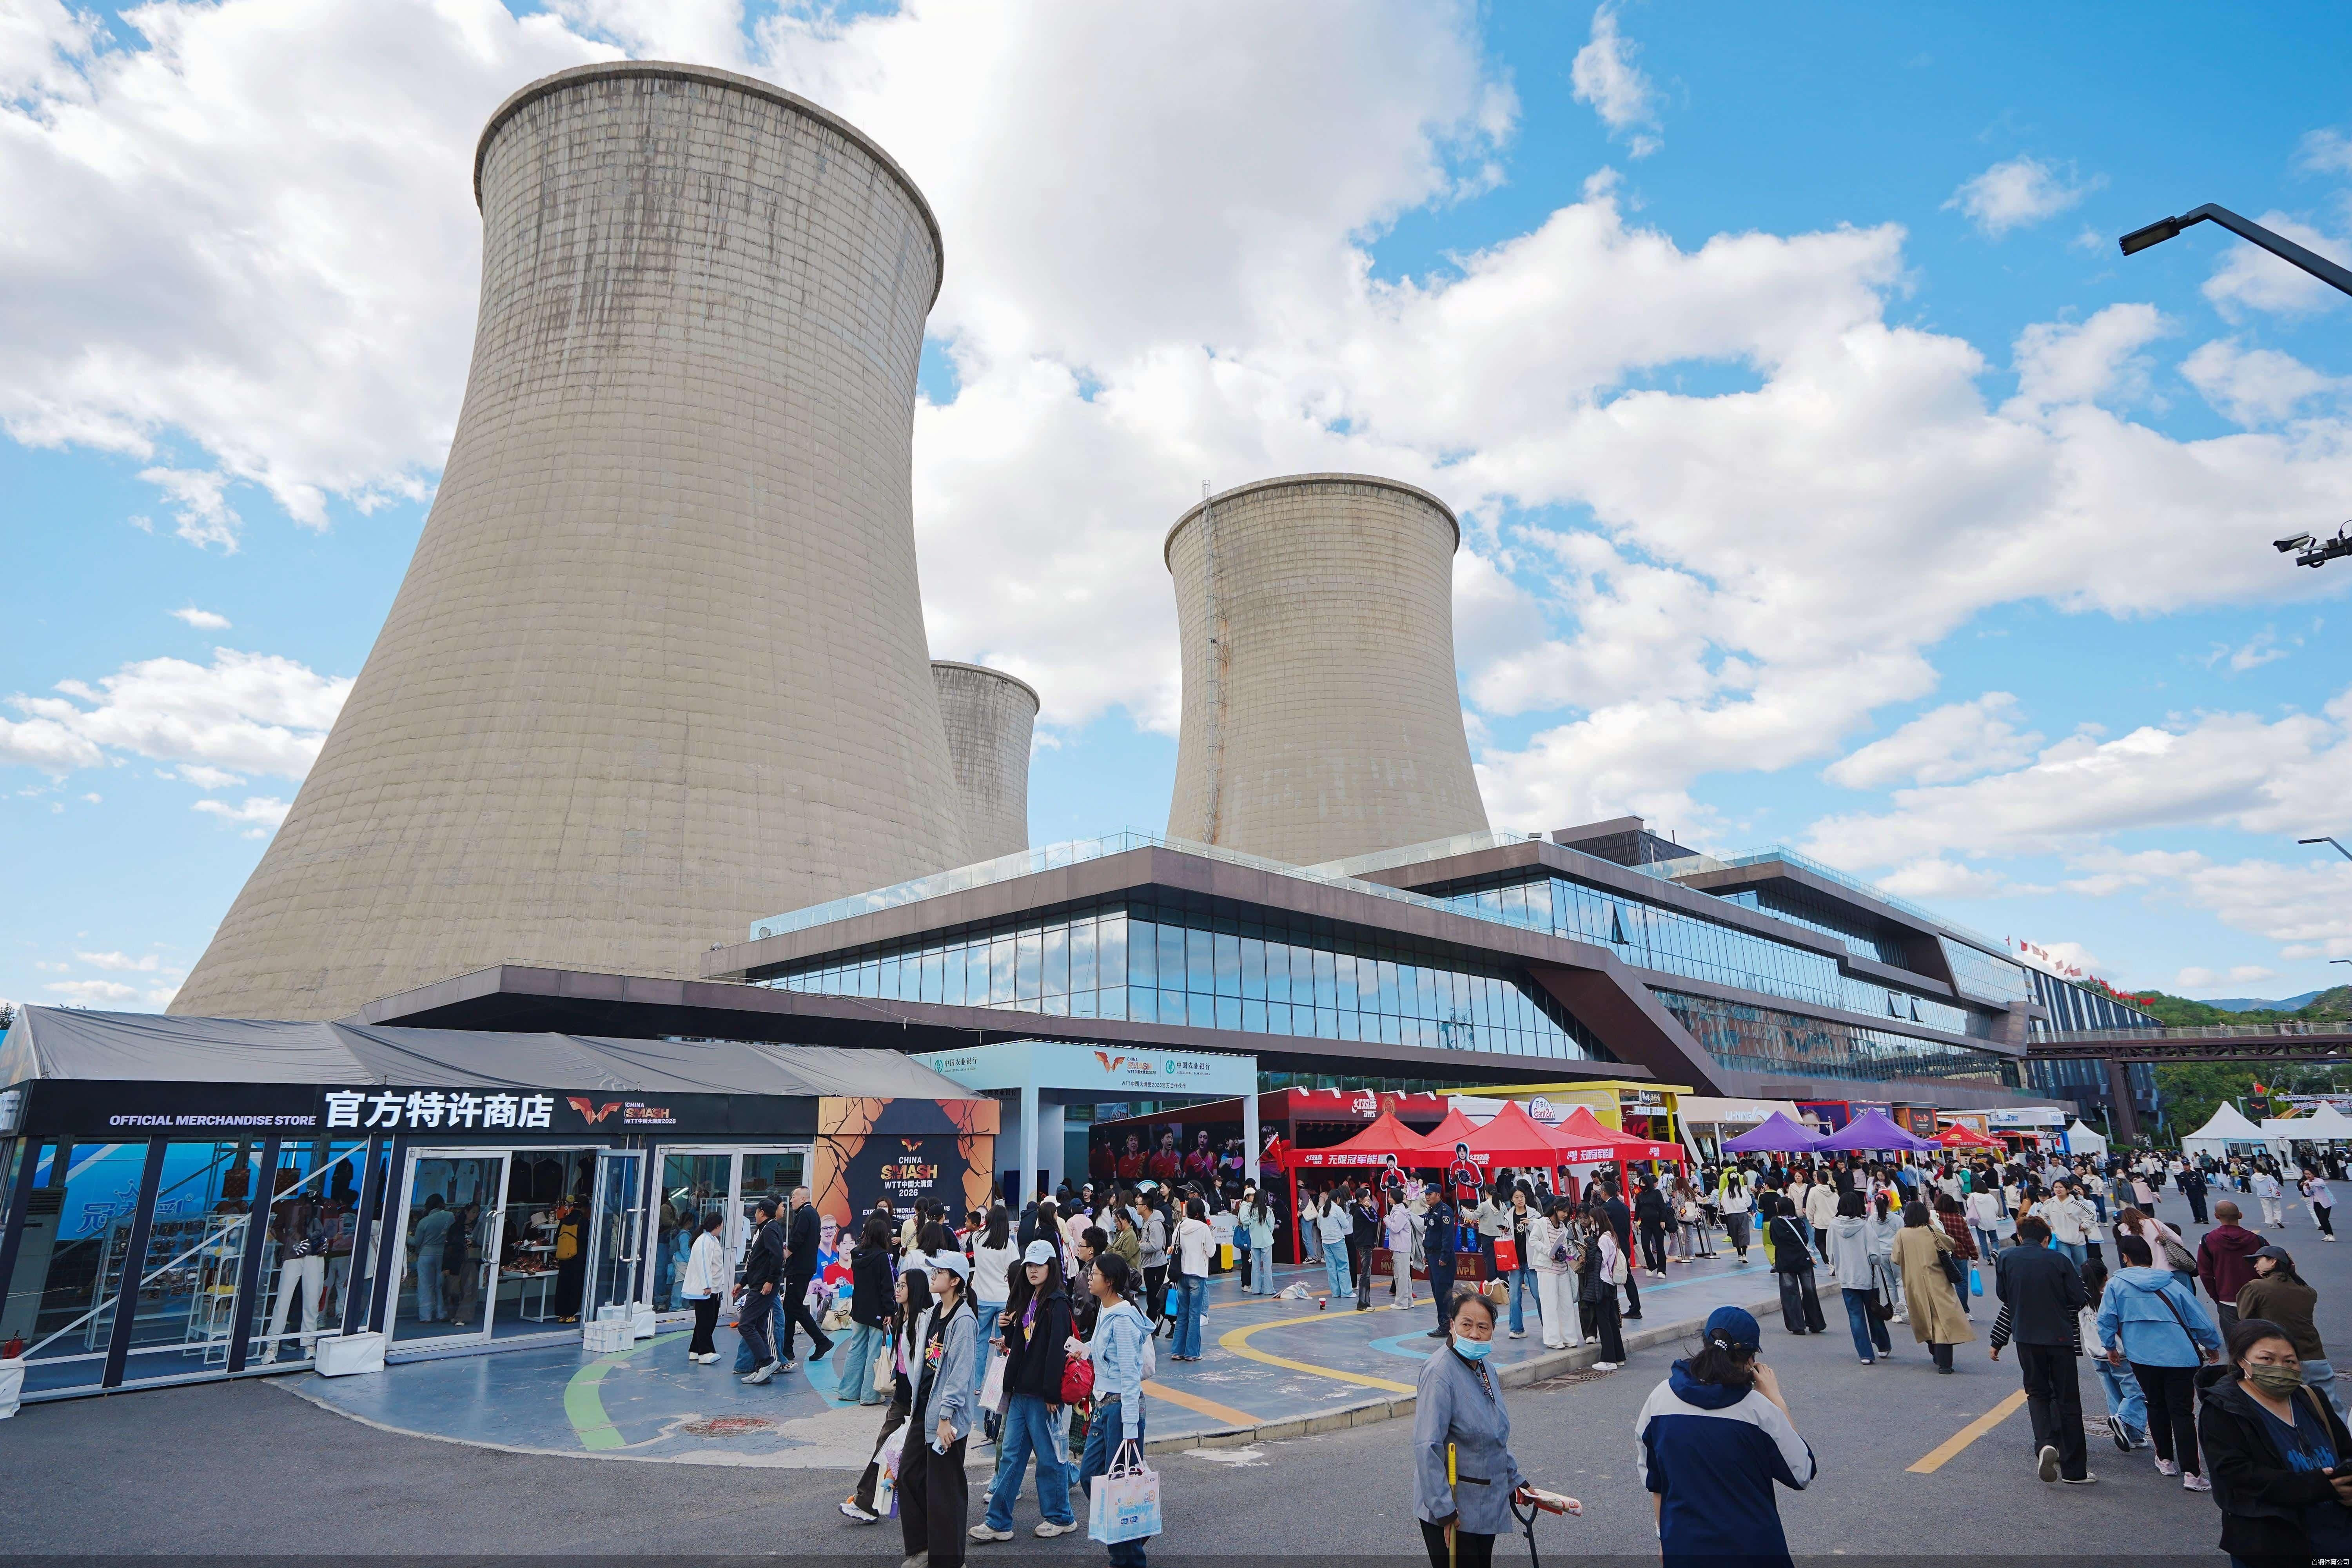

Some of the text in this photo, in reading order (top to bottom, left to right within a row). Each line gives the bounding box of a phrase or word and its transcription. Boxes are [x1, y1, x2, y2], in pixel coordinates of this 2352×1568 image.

[945, 1057, 977, 1067] 中国农业银行
[1127, 1061, 1152, 1070] SMASH
[1177, 1061, 1210, 1070] 中国农业银行
[325, 1090, 554, 1127] 官方特许商店
[1352, 1098, 1377, 1113] 红双喜
[624, 1108, 670, 1118] SMASH
[1725, 1110, 1752, 1121] LI-NING
[109, 1115, 317, 1125] OFFICIAL MERCHANDISE STORE
[1328, 1154, 1388, 1164] 无限冠军能量
[1580, 1148, 1614, 1160] 无限冠军能量
[881, 1164, 938, 1180] SMASH
[885, 1180, 933, 1189] WTT中国大满贯
